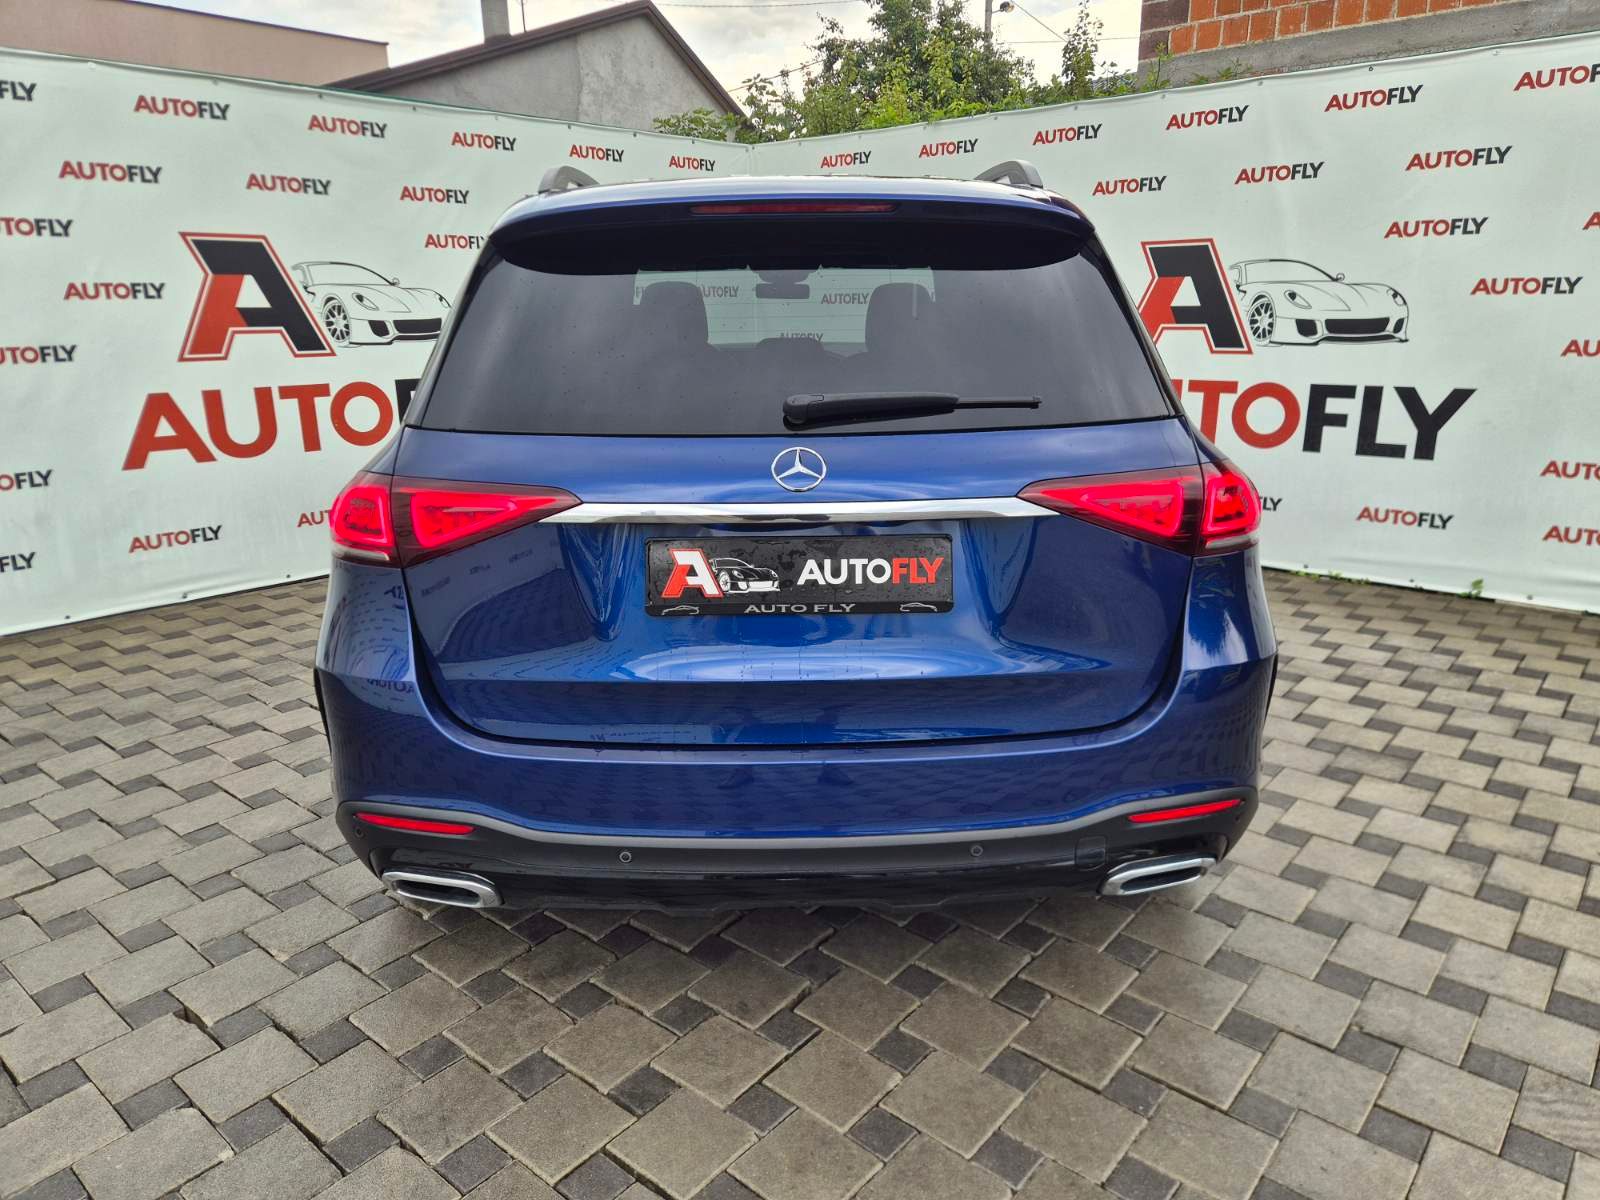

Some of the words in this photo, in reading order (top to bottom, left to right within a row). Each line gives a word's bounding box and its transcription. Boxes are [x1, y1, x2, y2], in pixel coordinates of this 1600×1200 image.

[134, 95, 230, 120] AUTOFLY
[1324, 85, 1423, 112] AUTOFLY
[308, 115, 387, 138] AUTOFLY
[1166, 105, 1249, 130] AUTOFLY
[451, 132, 516, 151] AUTOFLY
[1033, 123, 1102, 145] AUTOFLY
[569, 144, 624, 162] AUTOFLY
[919, 139, 978, 158] AUTOFLY
[1405, 146, 1512, 171] AUTOFLY
[669, 156, 715, 172] AUTOFLY
[821, 151, 871, 168] AUTOFLY
[59, 161, 162, 184] AUTOFLY
[1235, 162, 1325, 184] AUTOFLY
[246, 174, 331, 195] AUTOFLY
[400, 186, 469, 204] AUTOFLY
[1092, 176, 1167, 196] AUTOFLY
[1384, 217, 1488, 239] AUTOFLY
[64, 283, 165, 300] AUTOFLY
[702, 286, 739, 297] UTOFLY
[1470, 277, 1583, 295] AUTOFLY
[821, 294, 868, 304] AUTOFLY
[1356, 507, 1454, 530] AUTOFLY
[129, 525, 222, 553] AUTOFLY
[797, 557, 944, 585] AUTOFLY
[744, 604, 806, 613] AUTO
[813, 604, 856, 613] FLY
